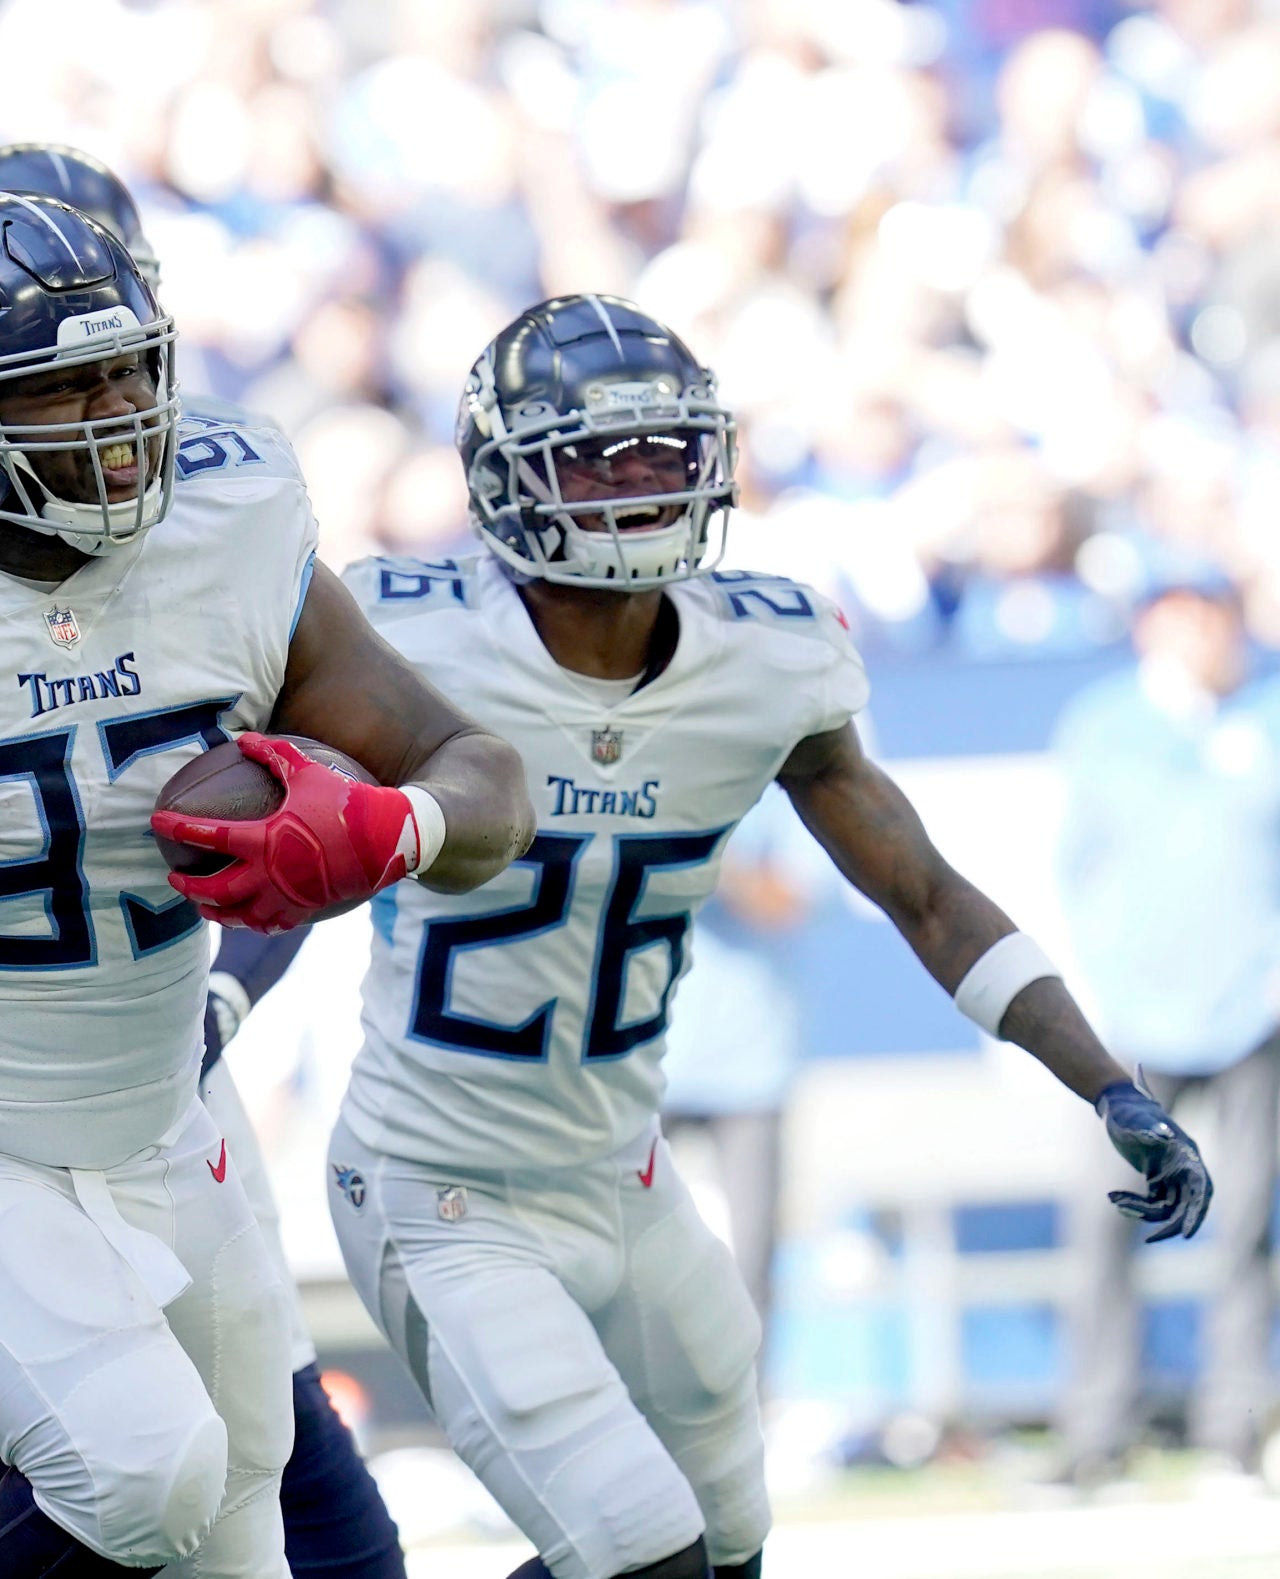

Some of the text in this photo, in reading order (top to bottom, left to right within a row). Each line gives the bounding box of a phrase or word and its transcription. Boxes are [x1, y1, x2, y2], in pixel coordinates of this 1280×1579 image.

[80, 312, 122, 336] TITANS
[53, 623, 77, 641] NFL
[17, 651, 141, 718] TITANS
[547, 776, 660, 818] TITANS
[405, 820, 740, 1065] 26
